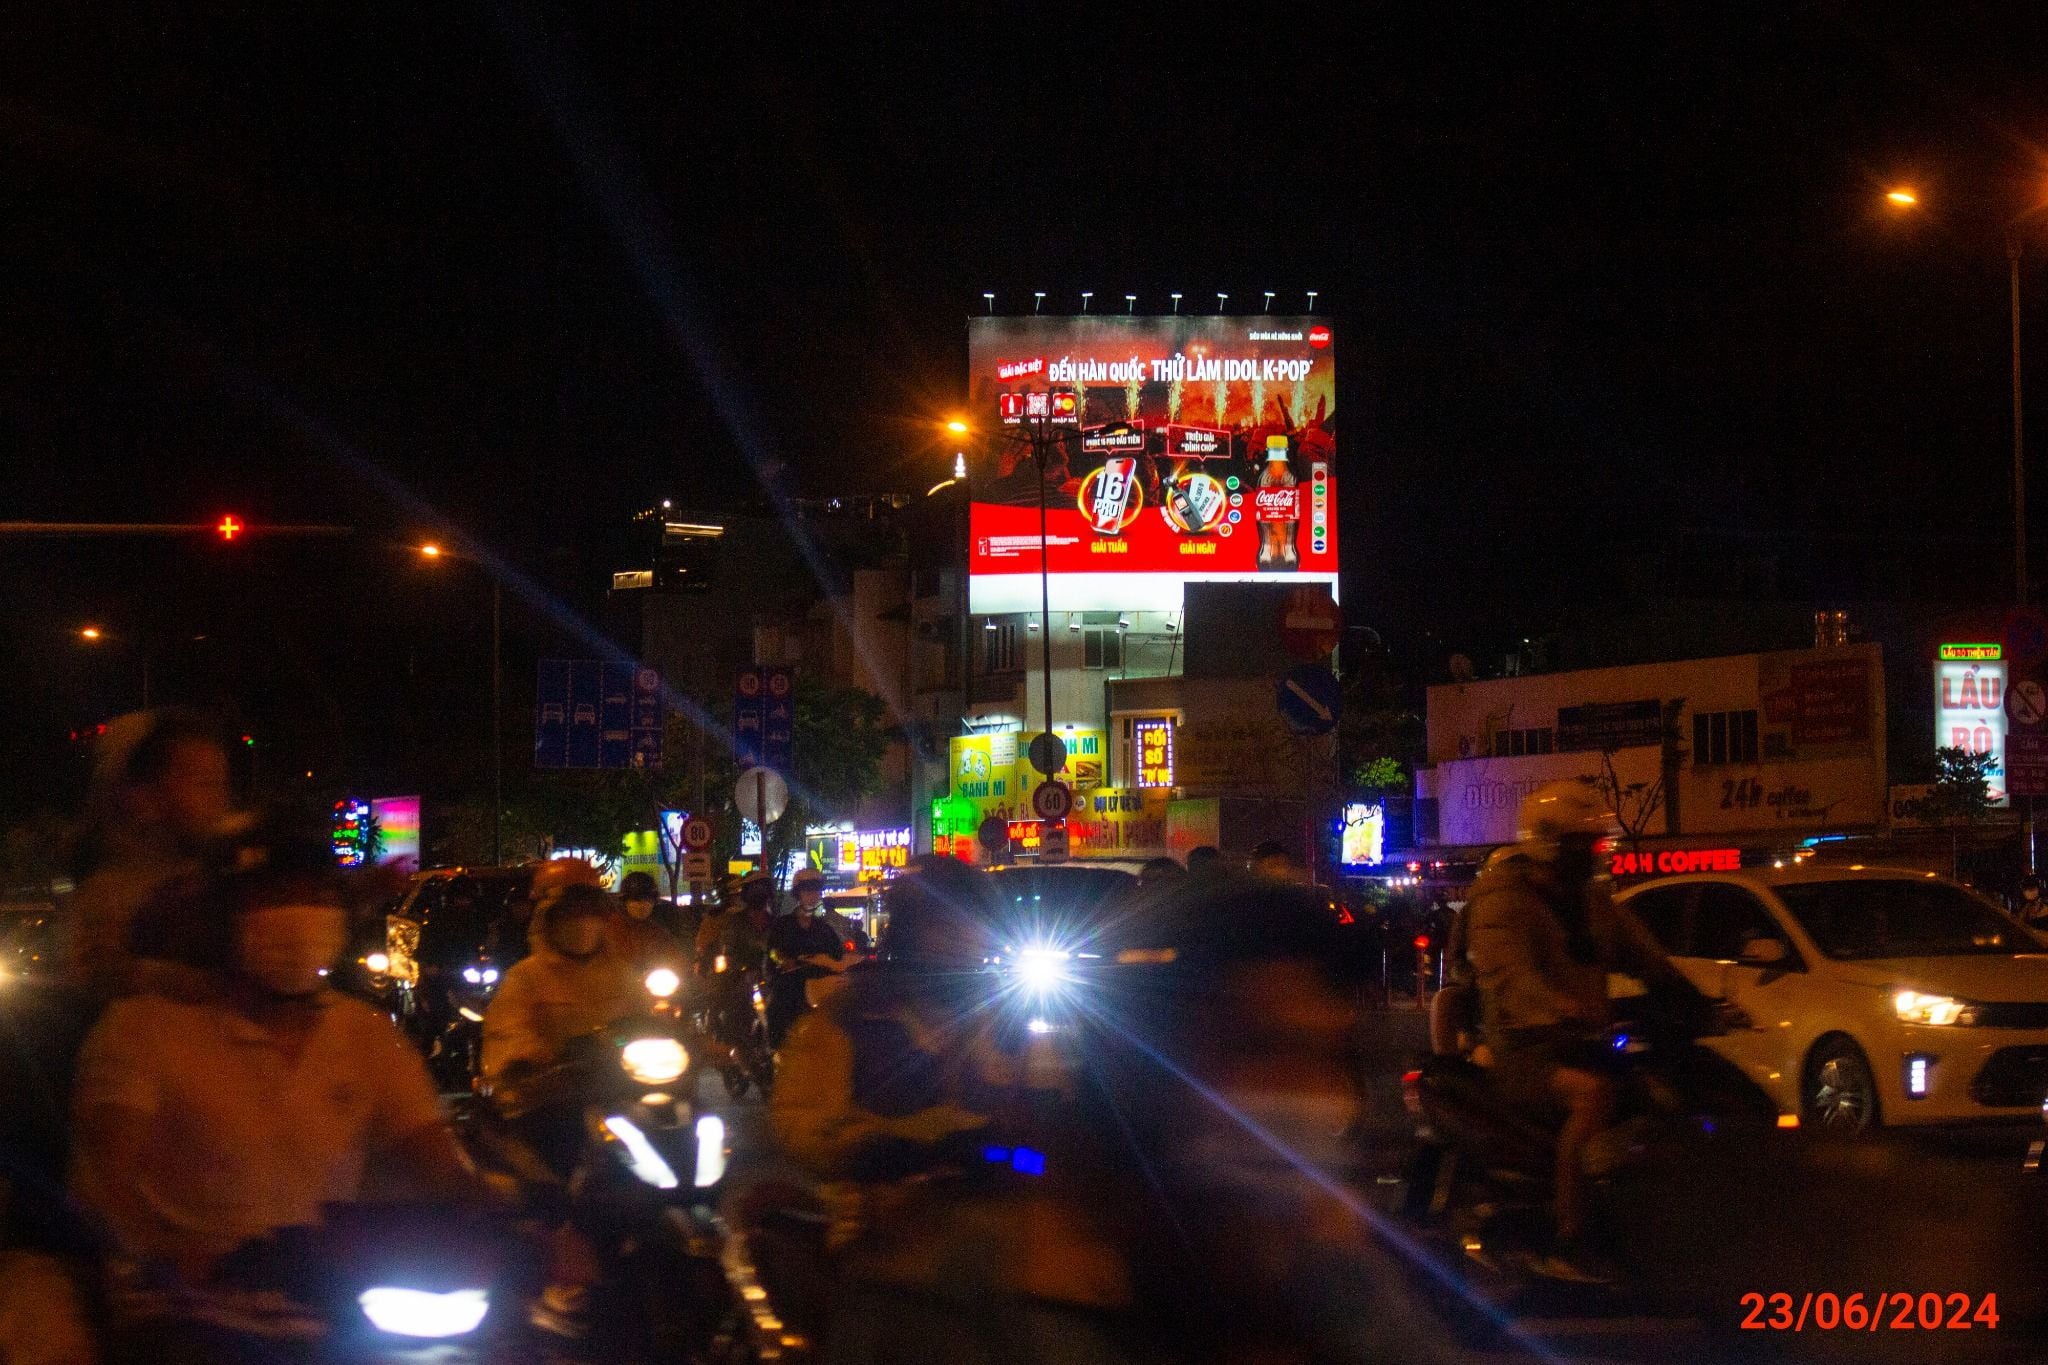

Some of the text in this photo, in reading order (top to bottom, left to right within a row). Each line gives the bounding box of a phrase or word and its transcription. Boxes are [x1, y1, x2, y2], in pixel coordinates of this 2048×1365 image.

[1049, 356, 1075, 381] ĐẾN
[1079, 358, 1107, 381] HÀN
[1109, 355, 1146, 382] QUỐC
[1151, 353, 1185, 381] THỬ
[1187, 353, 1220, 381] LÀM
[1224, 359, 1261, 381] IDOL
[1096, 472, 1124, 504] 16
[1093, 499, 1120, 518] PRO
[1942, 664, 2000, 709] LẨU
[1952, 718, 1993, 756] BÒ
[1046, 794, 1059, 810] 60
[691, 826, 704, 837] 80
[1612, 849, 1740, 874] 24H COFFEE
